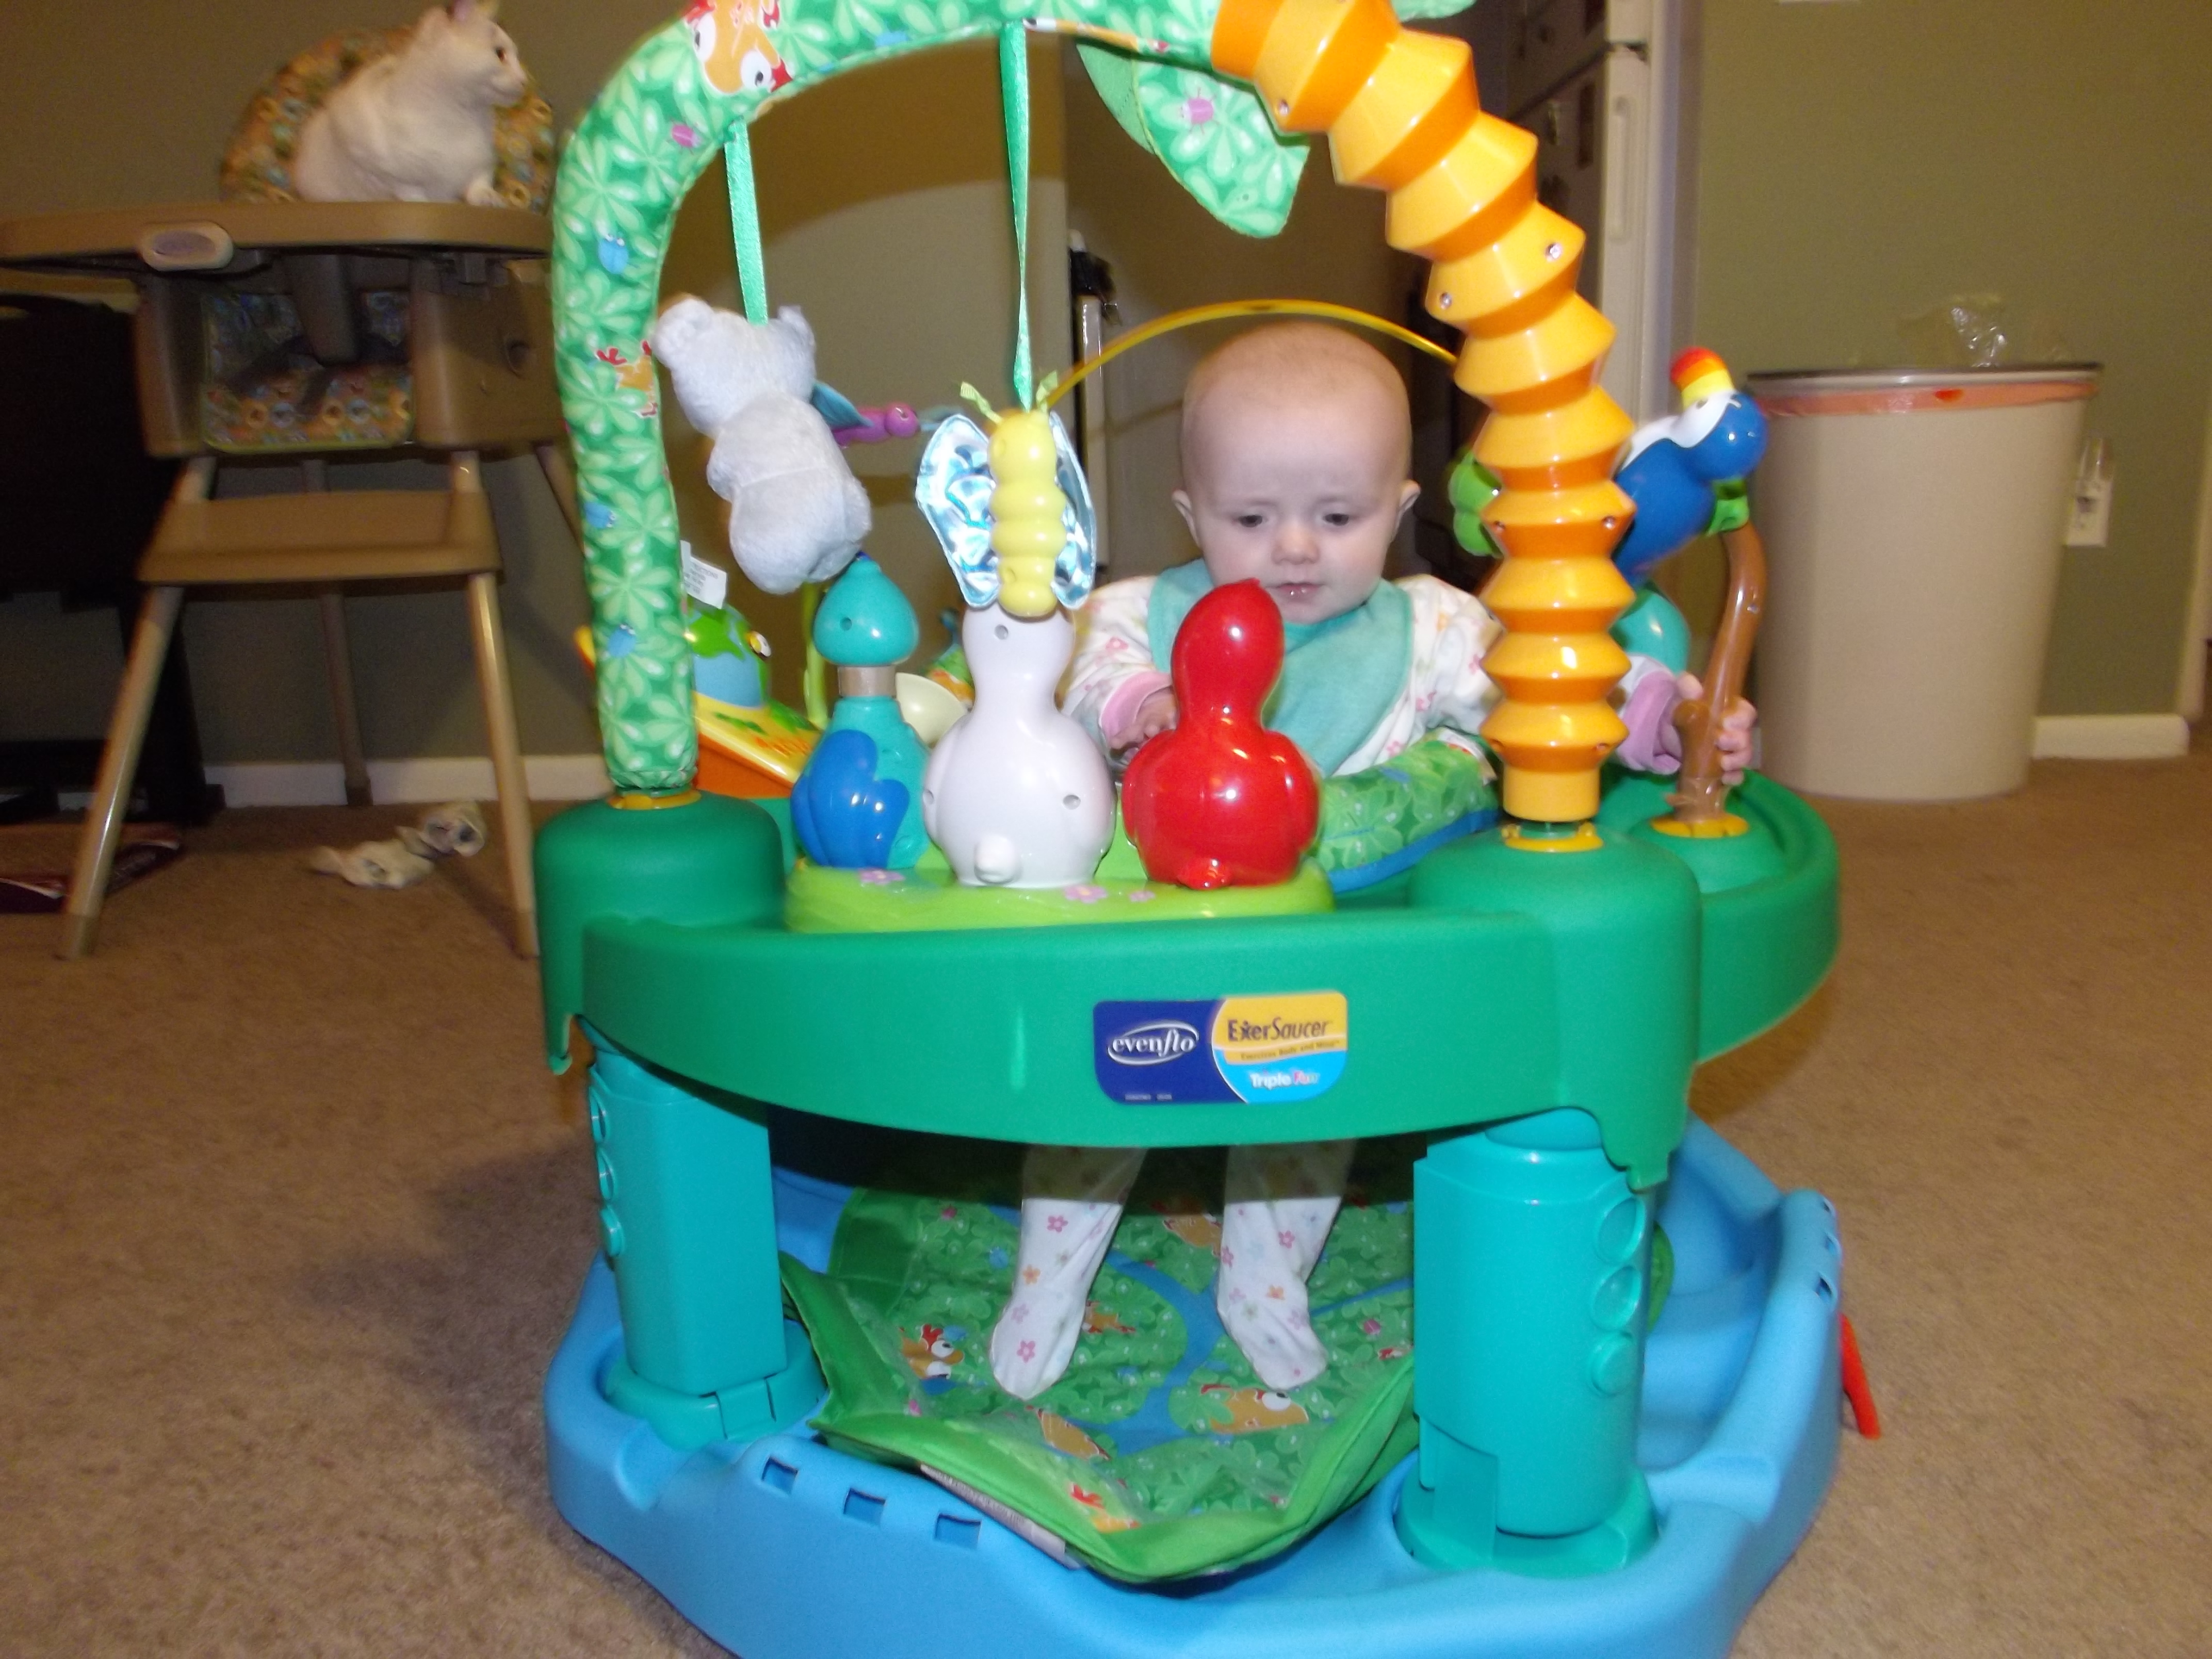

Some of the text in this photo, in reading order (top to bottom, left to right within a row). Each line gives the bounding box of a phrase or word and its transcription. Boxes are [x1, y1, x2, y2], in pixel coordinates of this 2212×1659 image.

[1227, 1016, 1329, 1042] ExerSaucer
[1112, 1028, 1196, 1057] evenflo
[1249, 1070, 1291, 1089] Triple
